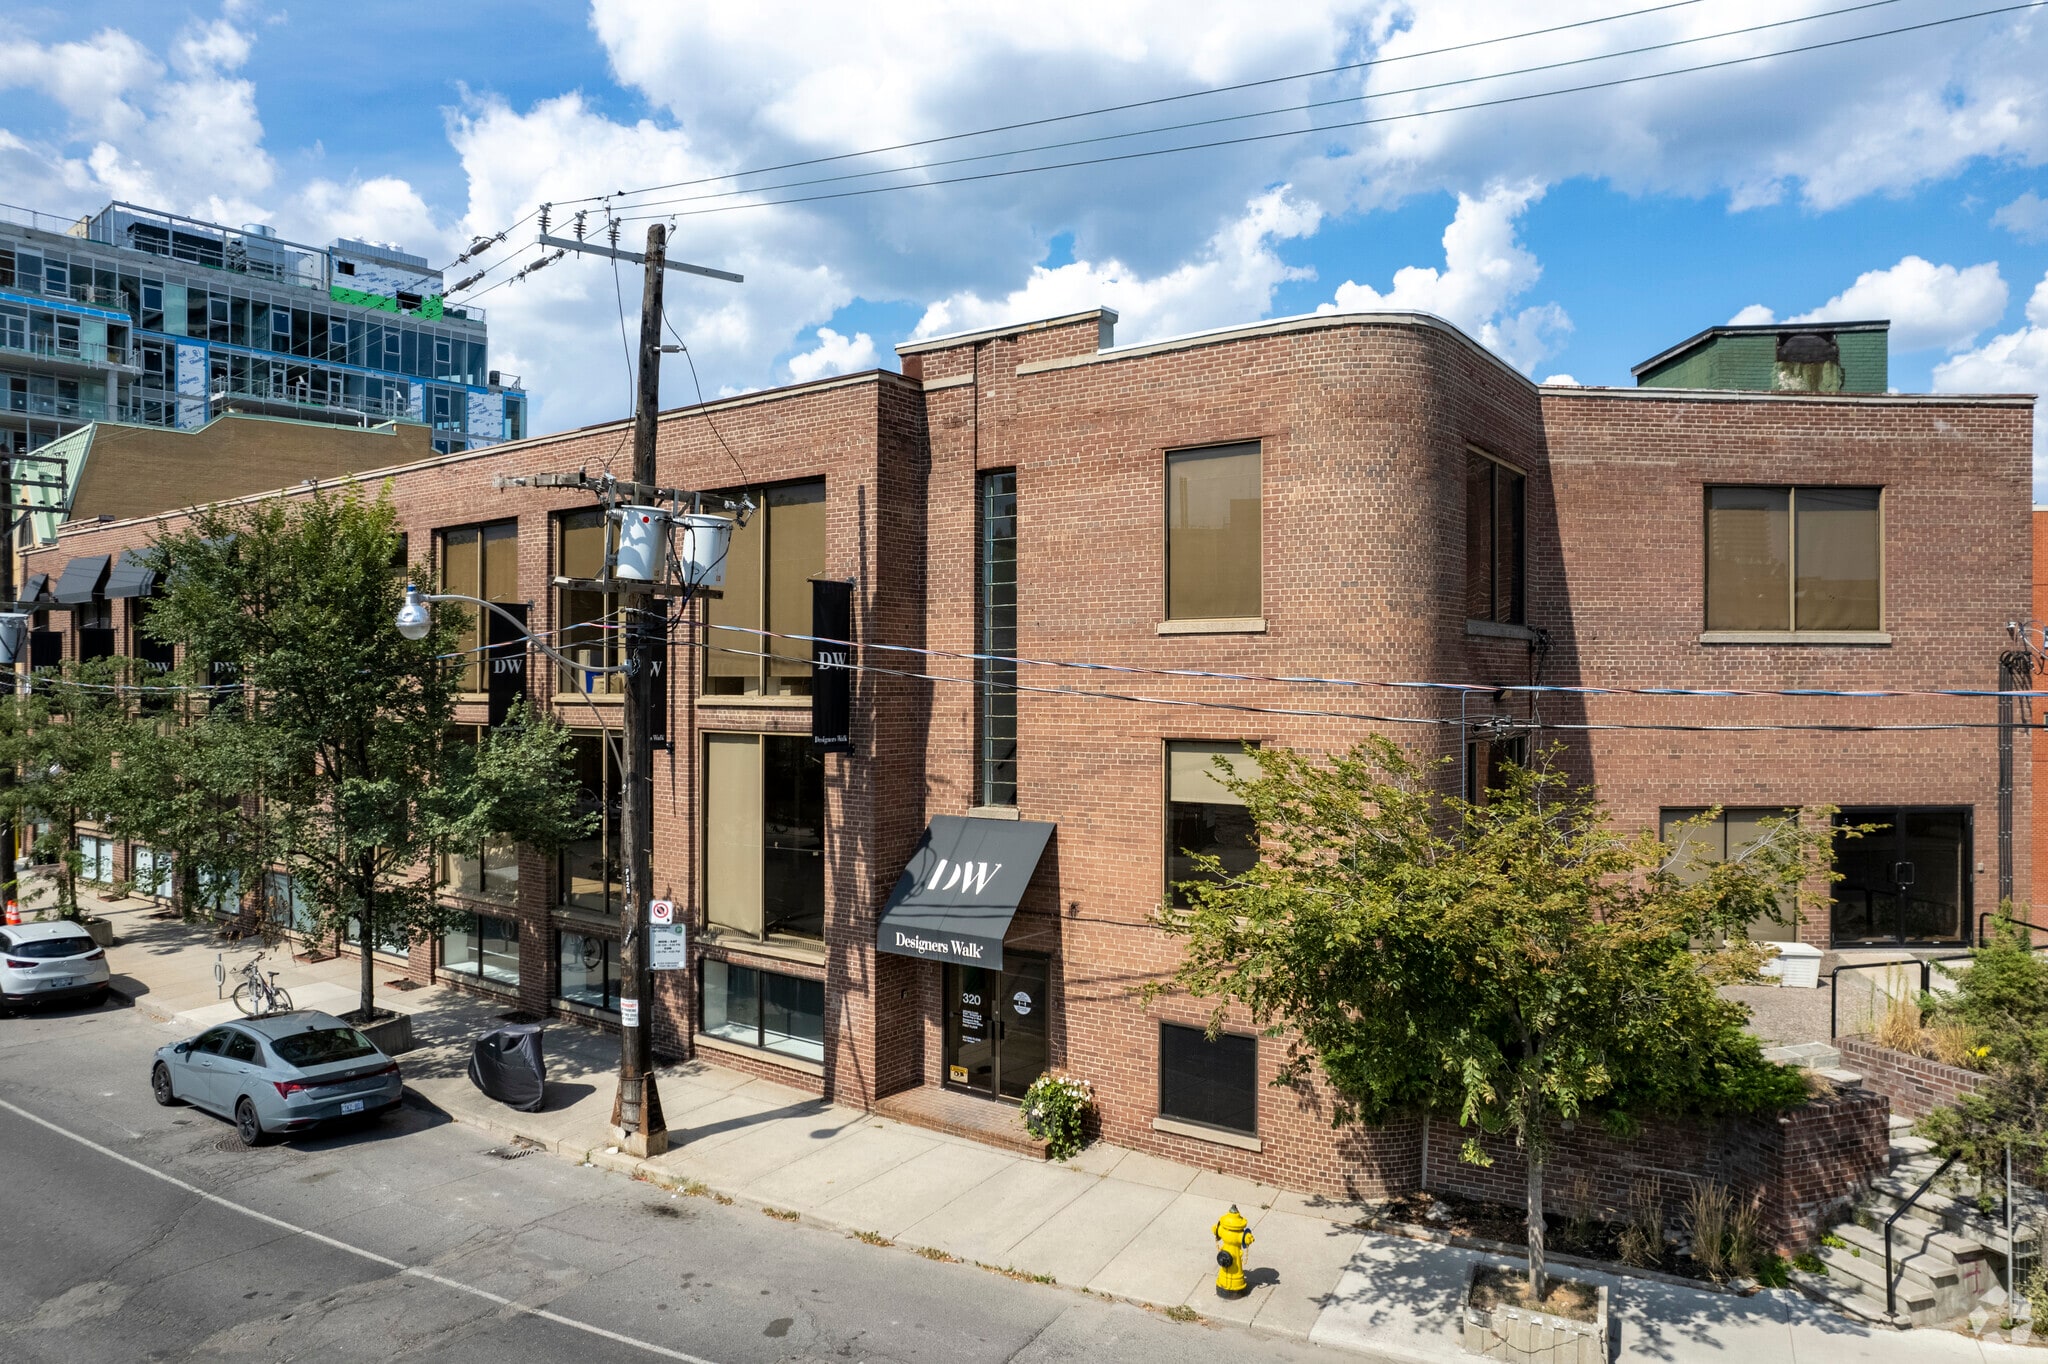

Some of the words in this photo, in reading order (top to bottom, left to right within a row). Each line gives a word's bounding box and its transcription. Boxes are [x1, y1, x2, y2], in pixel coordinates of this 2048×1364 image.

[494, 659, 523, 674] DW
[650, 661, 663, 677] W
[818, 651, 847, 670] DW
[927, 859, 1002, 896] DW
[895, 932, 949, 954] Designers
[950, 939, 982, 959] Walk
[962, 992, 981, 1006] 320
